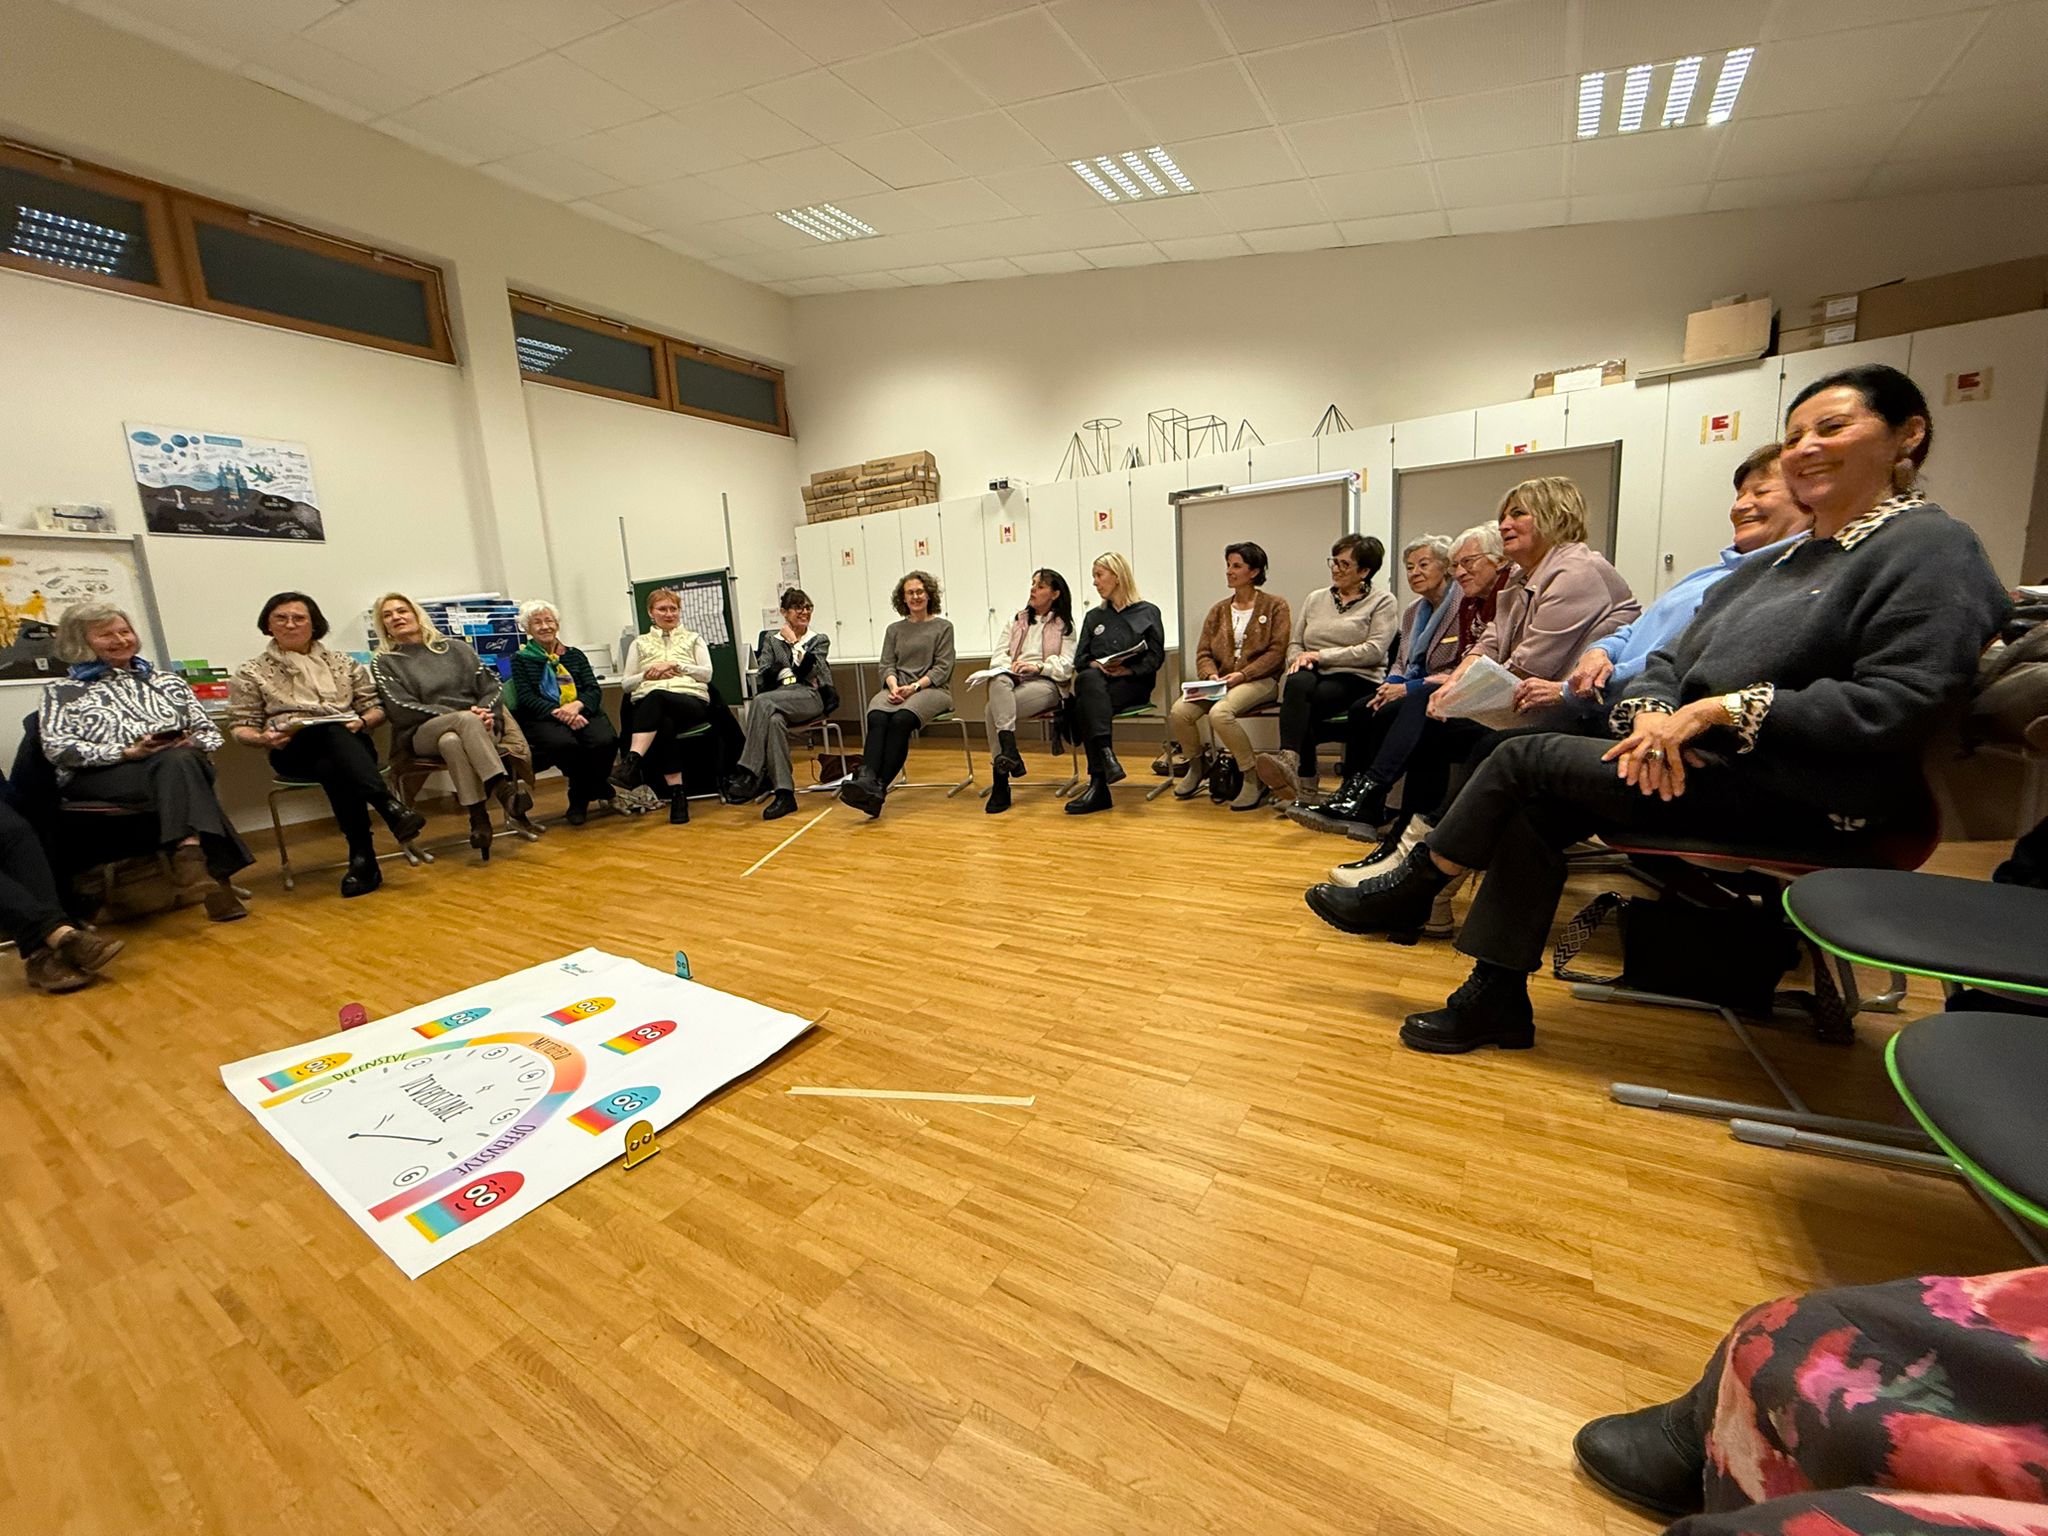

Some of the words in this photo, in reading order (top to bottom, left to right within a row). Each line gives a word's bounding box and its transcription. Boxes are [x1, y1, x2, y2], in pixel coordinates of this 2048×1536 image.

[1957, 371, 1981, 390] E
[1711, 415, 1729, 431] E
[1098, 511, 1108, 522] P
[331, 1052, 409, 1082] DEFENSIVE
[452, 1124, 537, 1176] OFFENSIVE
